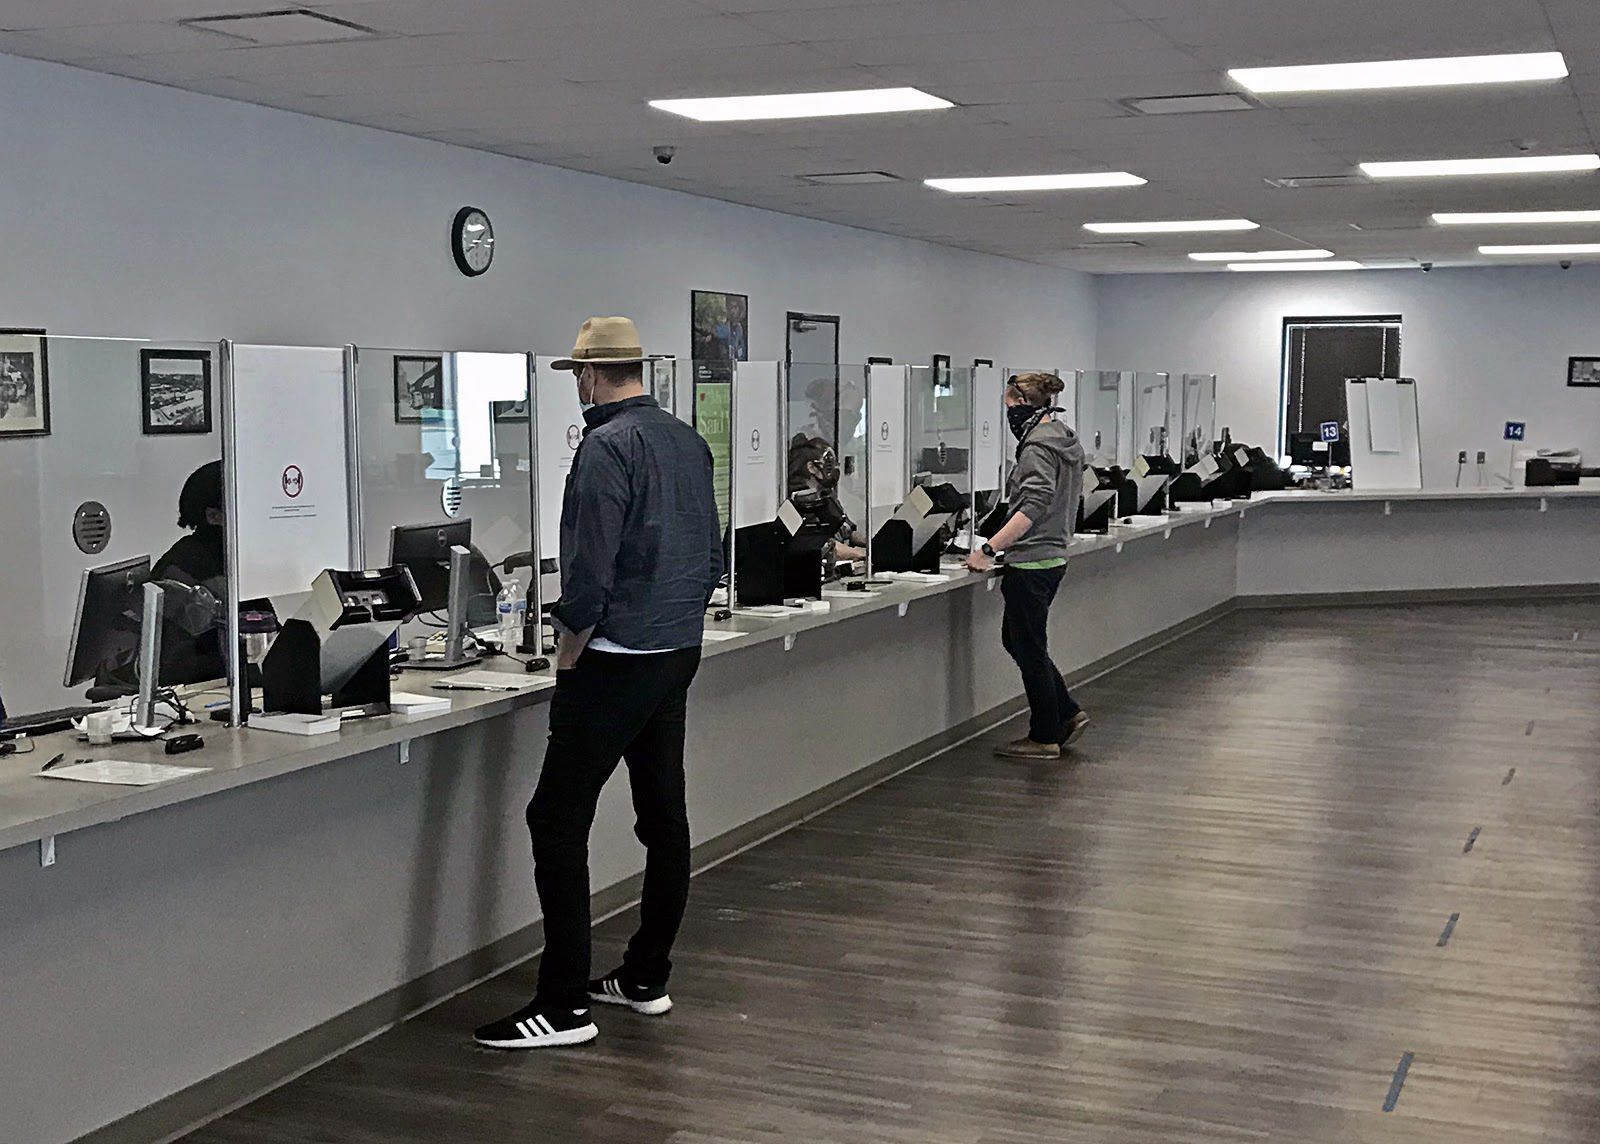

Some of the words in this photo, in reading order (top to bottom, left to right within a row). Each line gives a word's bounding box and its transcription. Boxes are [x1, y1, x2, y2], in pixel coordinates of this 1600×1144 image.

[700, 411, 724, 434] Said
[1324, 426, 1336, 437] 13
[1509, 426, 1521, 436] 14
